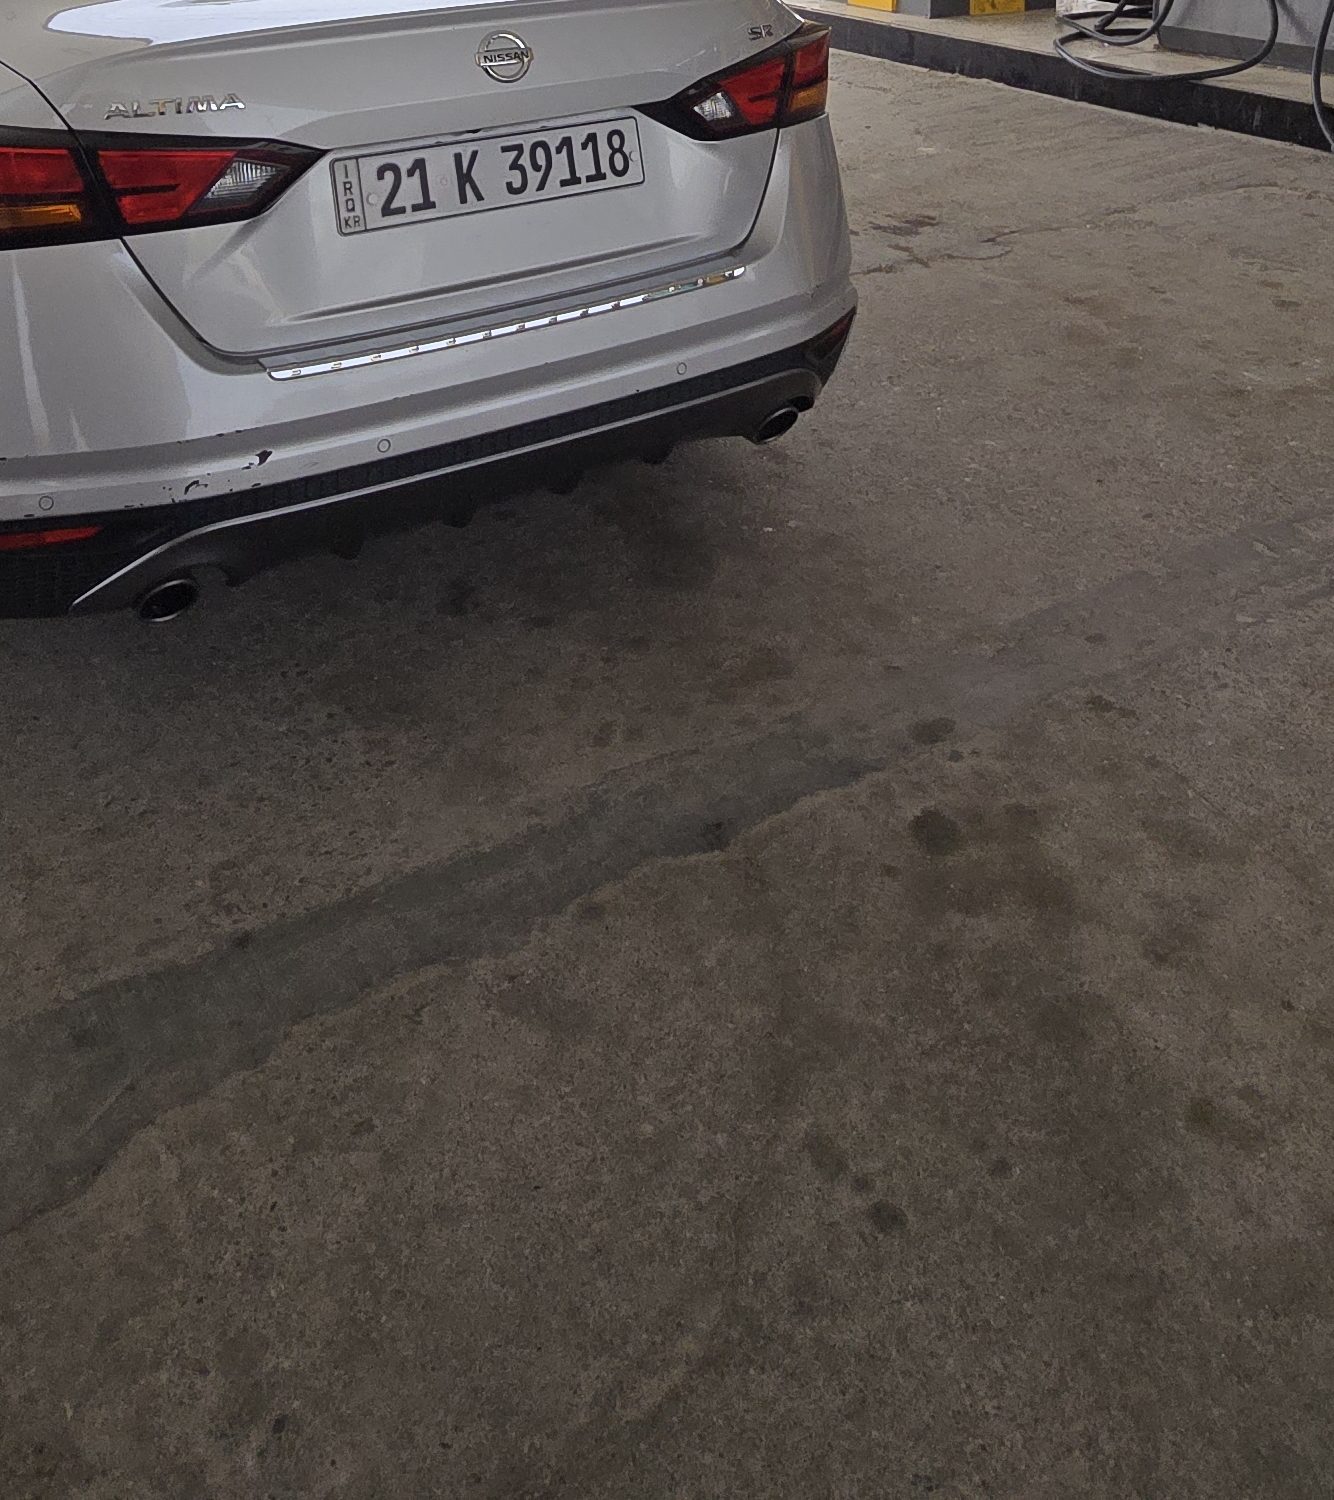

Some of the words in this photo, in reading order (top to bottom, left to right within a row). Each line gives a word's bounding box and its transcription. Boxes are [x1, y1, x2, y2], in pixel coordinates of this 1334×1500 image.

[748, 24, 774, 40] SR
[483, 50, 529, 63] NISSAN
[103, 93, 246, 120] ALTIMA
[376, 157, 437, 218] 21
[453, 149, 485, 204] K
[500, 129, 630, 196] 39118
[343, 215, 361, 229] KR
